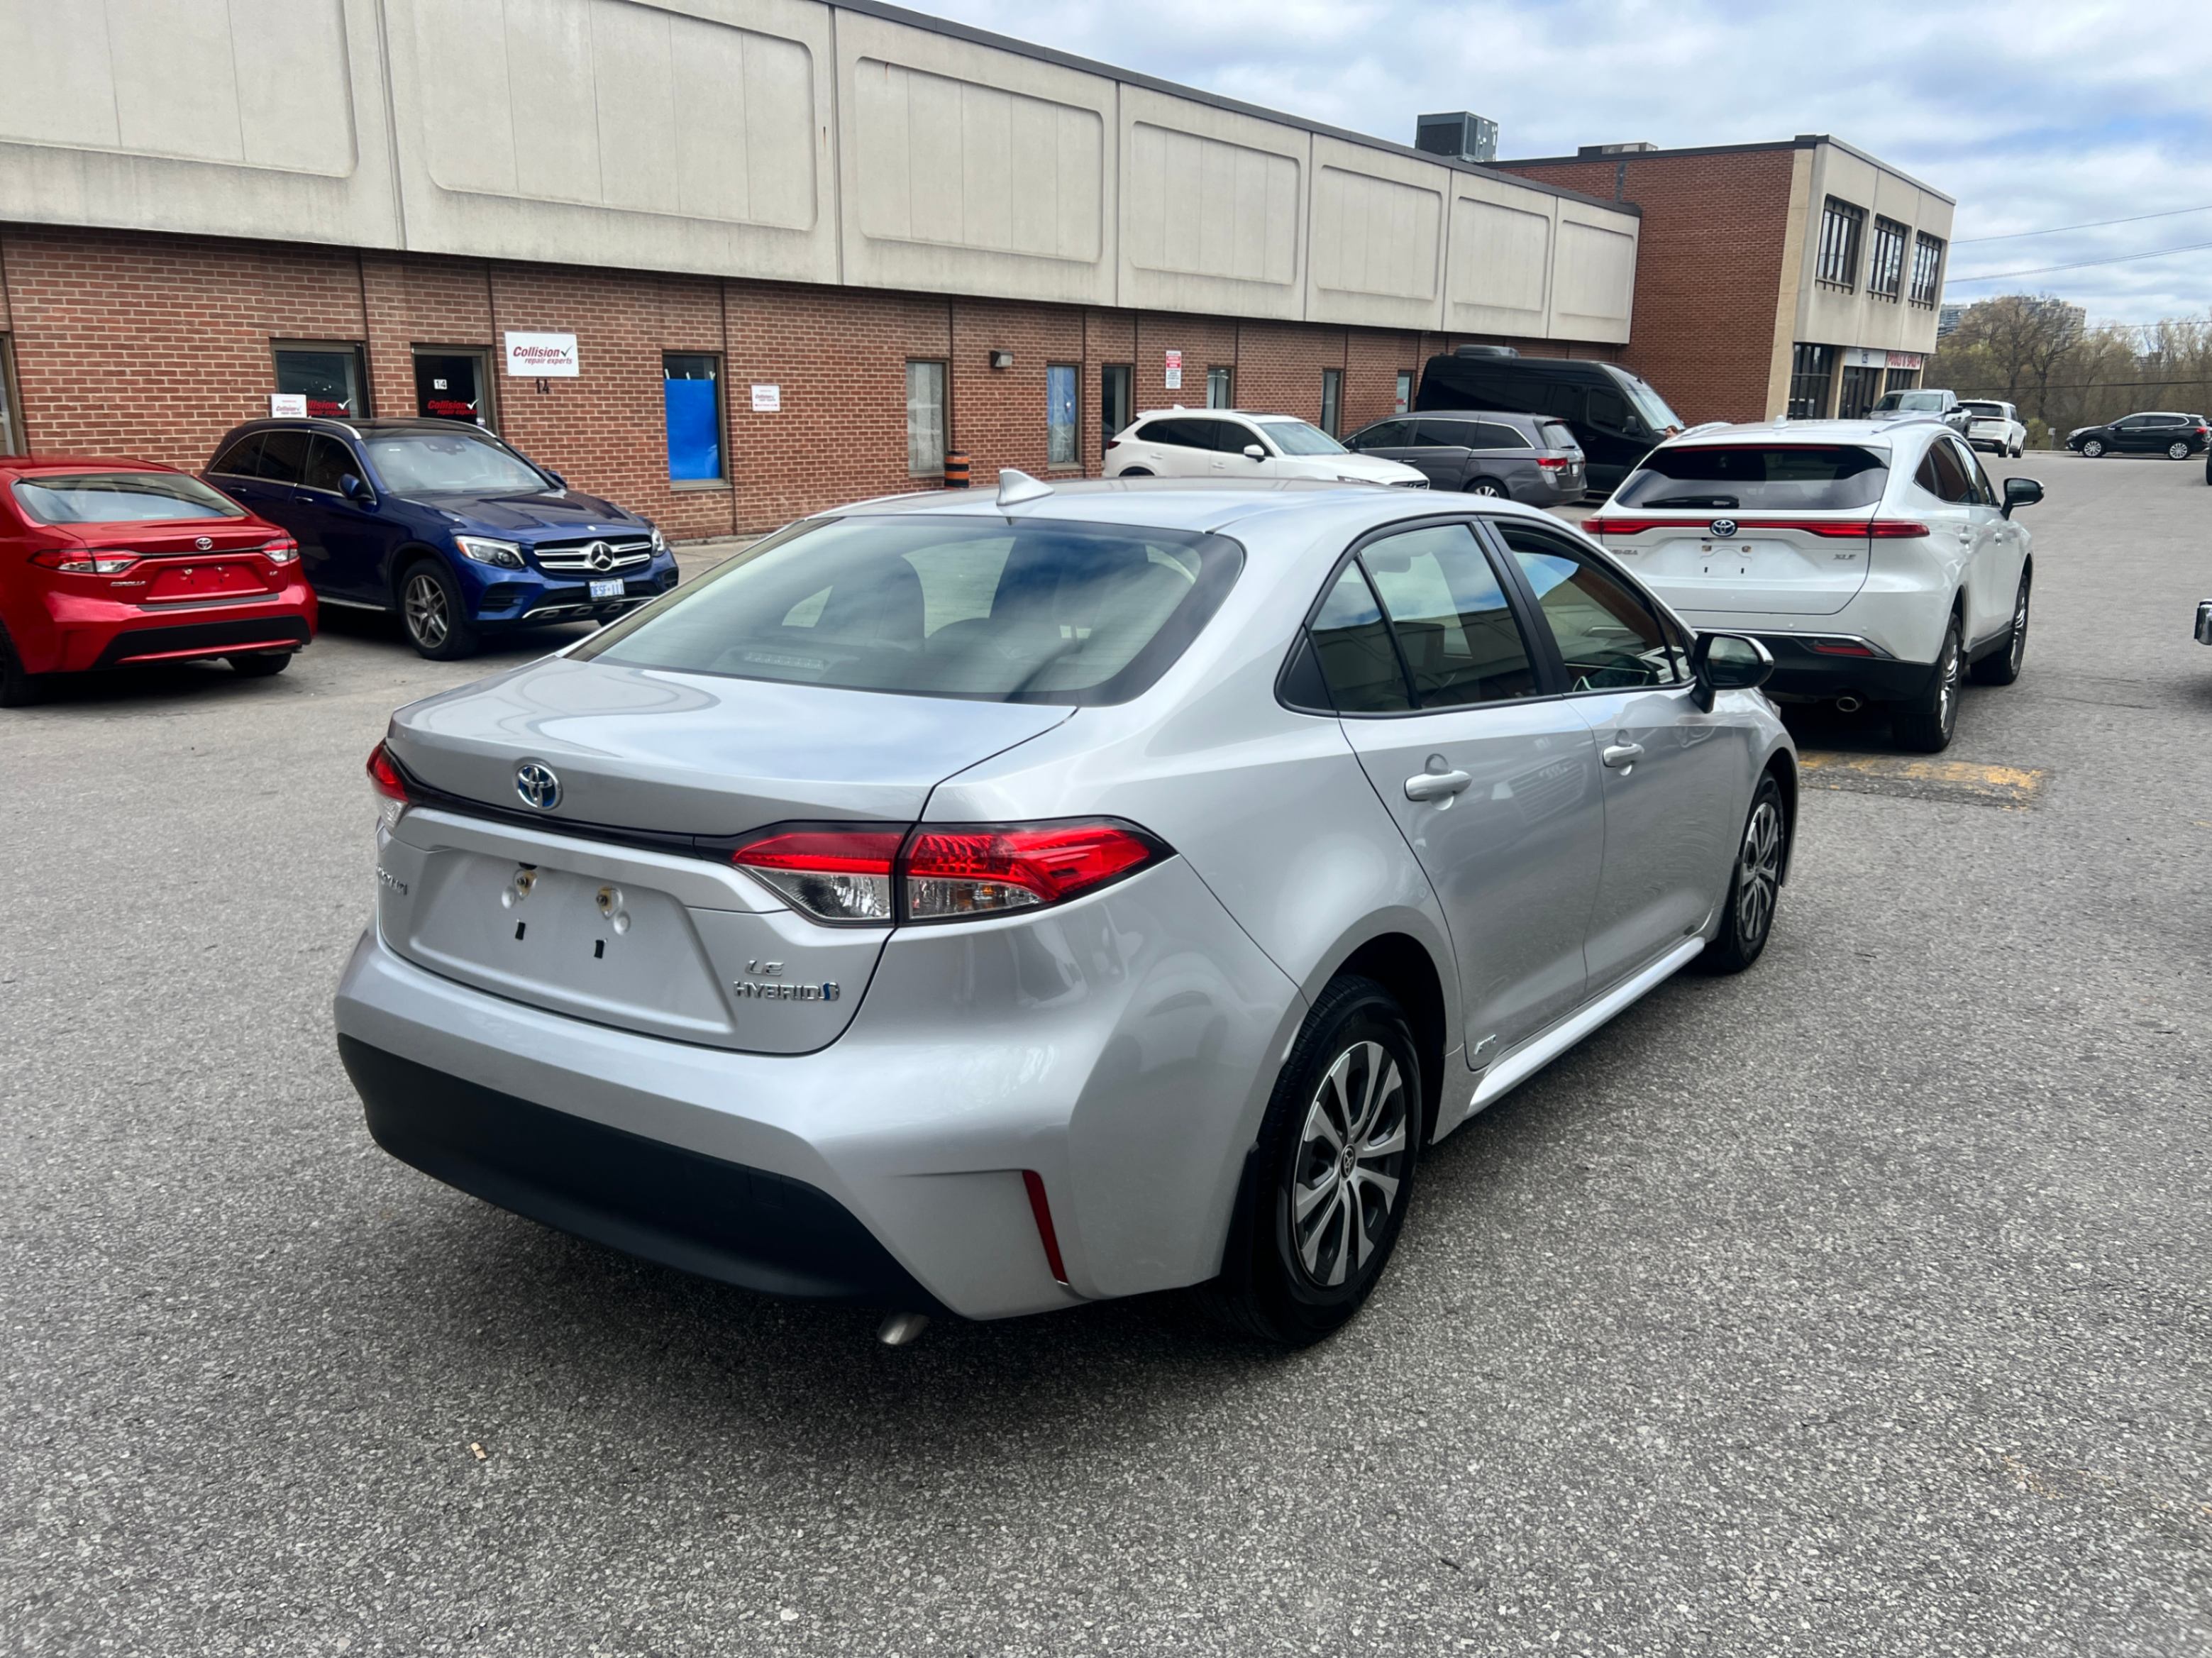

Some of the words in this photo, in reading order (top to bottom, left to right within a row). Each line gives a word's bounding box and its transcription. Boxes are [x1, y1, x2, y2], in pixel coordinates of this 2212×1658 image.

[513, 346, 560, 358] Collision
[436, 380, 446, 388] 14
[536, 378, 550, 394] 14
[307, 399, 338, 409] llision
[428, 399, 467, 409] Collision
[745, 960, 784, 976] LE
[734, 981, 822, 1001] HYBRID
